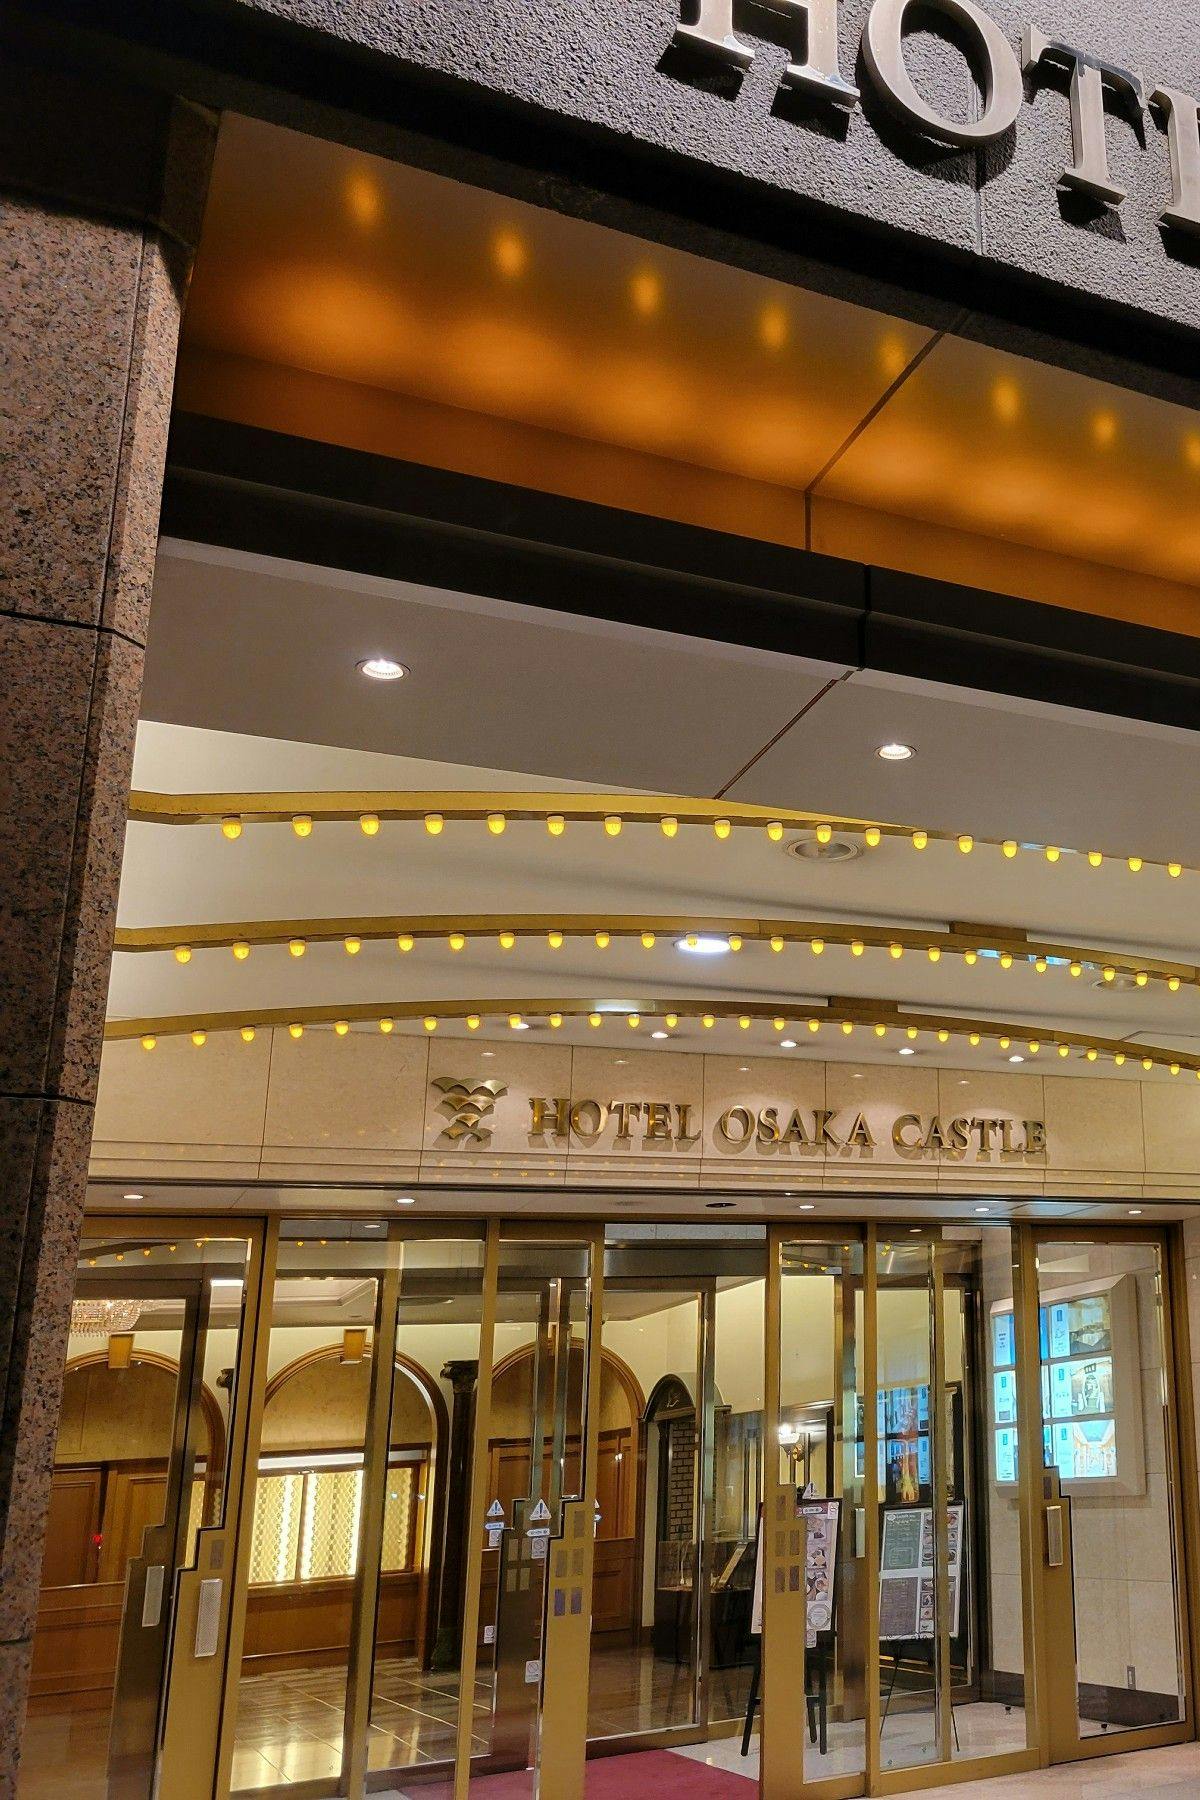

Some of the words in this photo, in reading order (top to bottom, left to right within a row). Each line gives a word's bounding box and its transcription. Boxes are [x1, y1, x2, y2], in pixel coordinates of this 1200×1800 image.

[527, 1097, 702, 1141] HOTEL
[721, 1104, 877, 1147] OSAKA
[892, 1113, 1047, 1152] CASTLE
